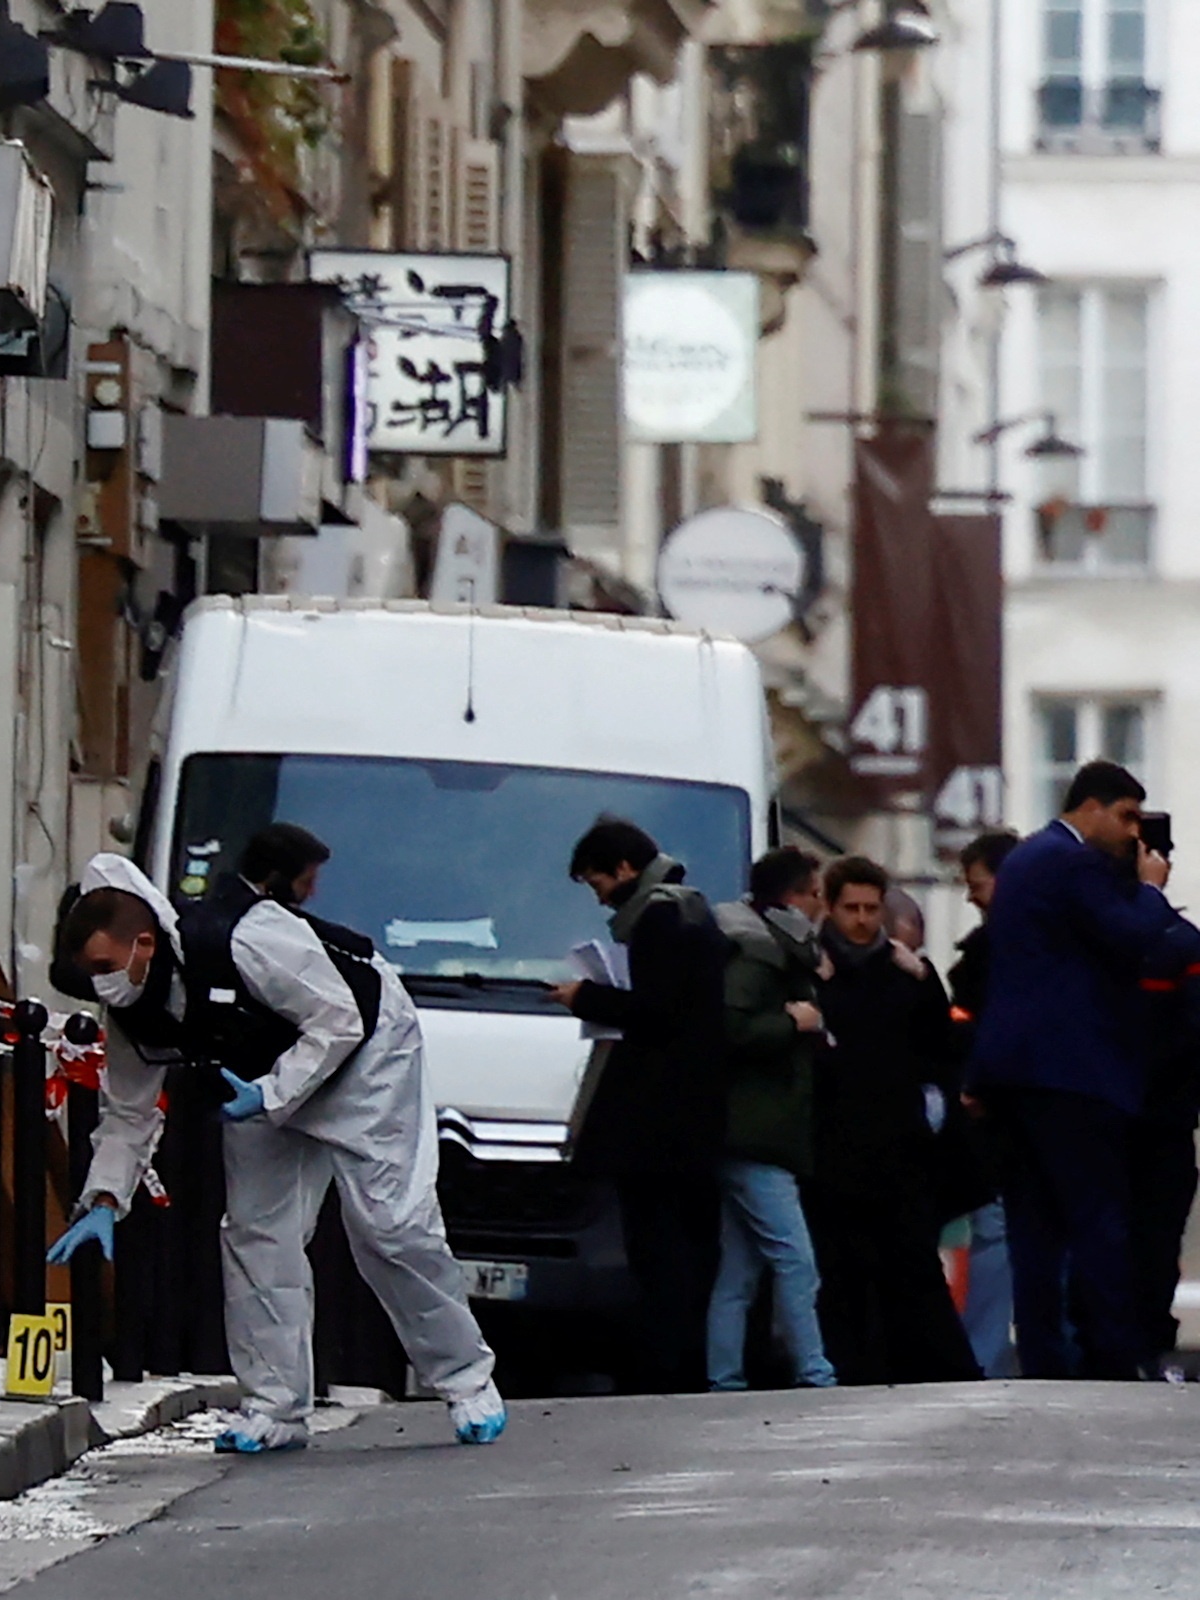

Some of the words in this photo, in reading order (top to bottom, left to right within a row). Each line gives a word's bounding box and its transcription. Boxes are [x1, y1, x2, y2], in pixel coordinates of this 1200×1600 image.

[851, 685, 927, 751] 41
[933, 766, 1003, 826] 41
[15, 1326, 51, 1381] 10
